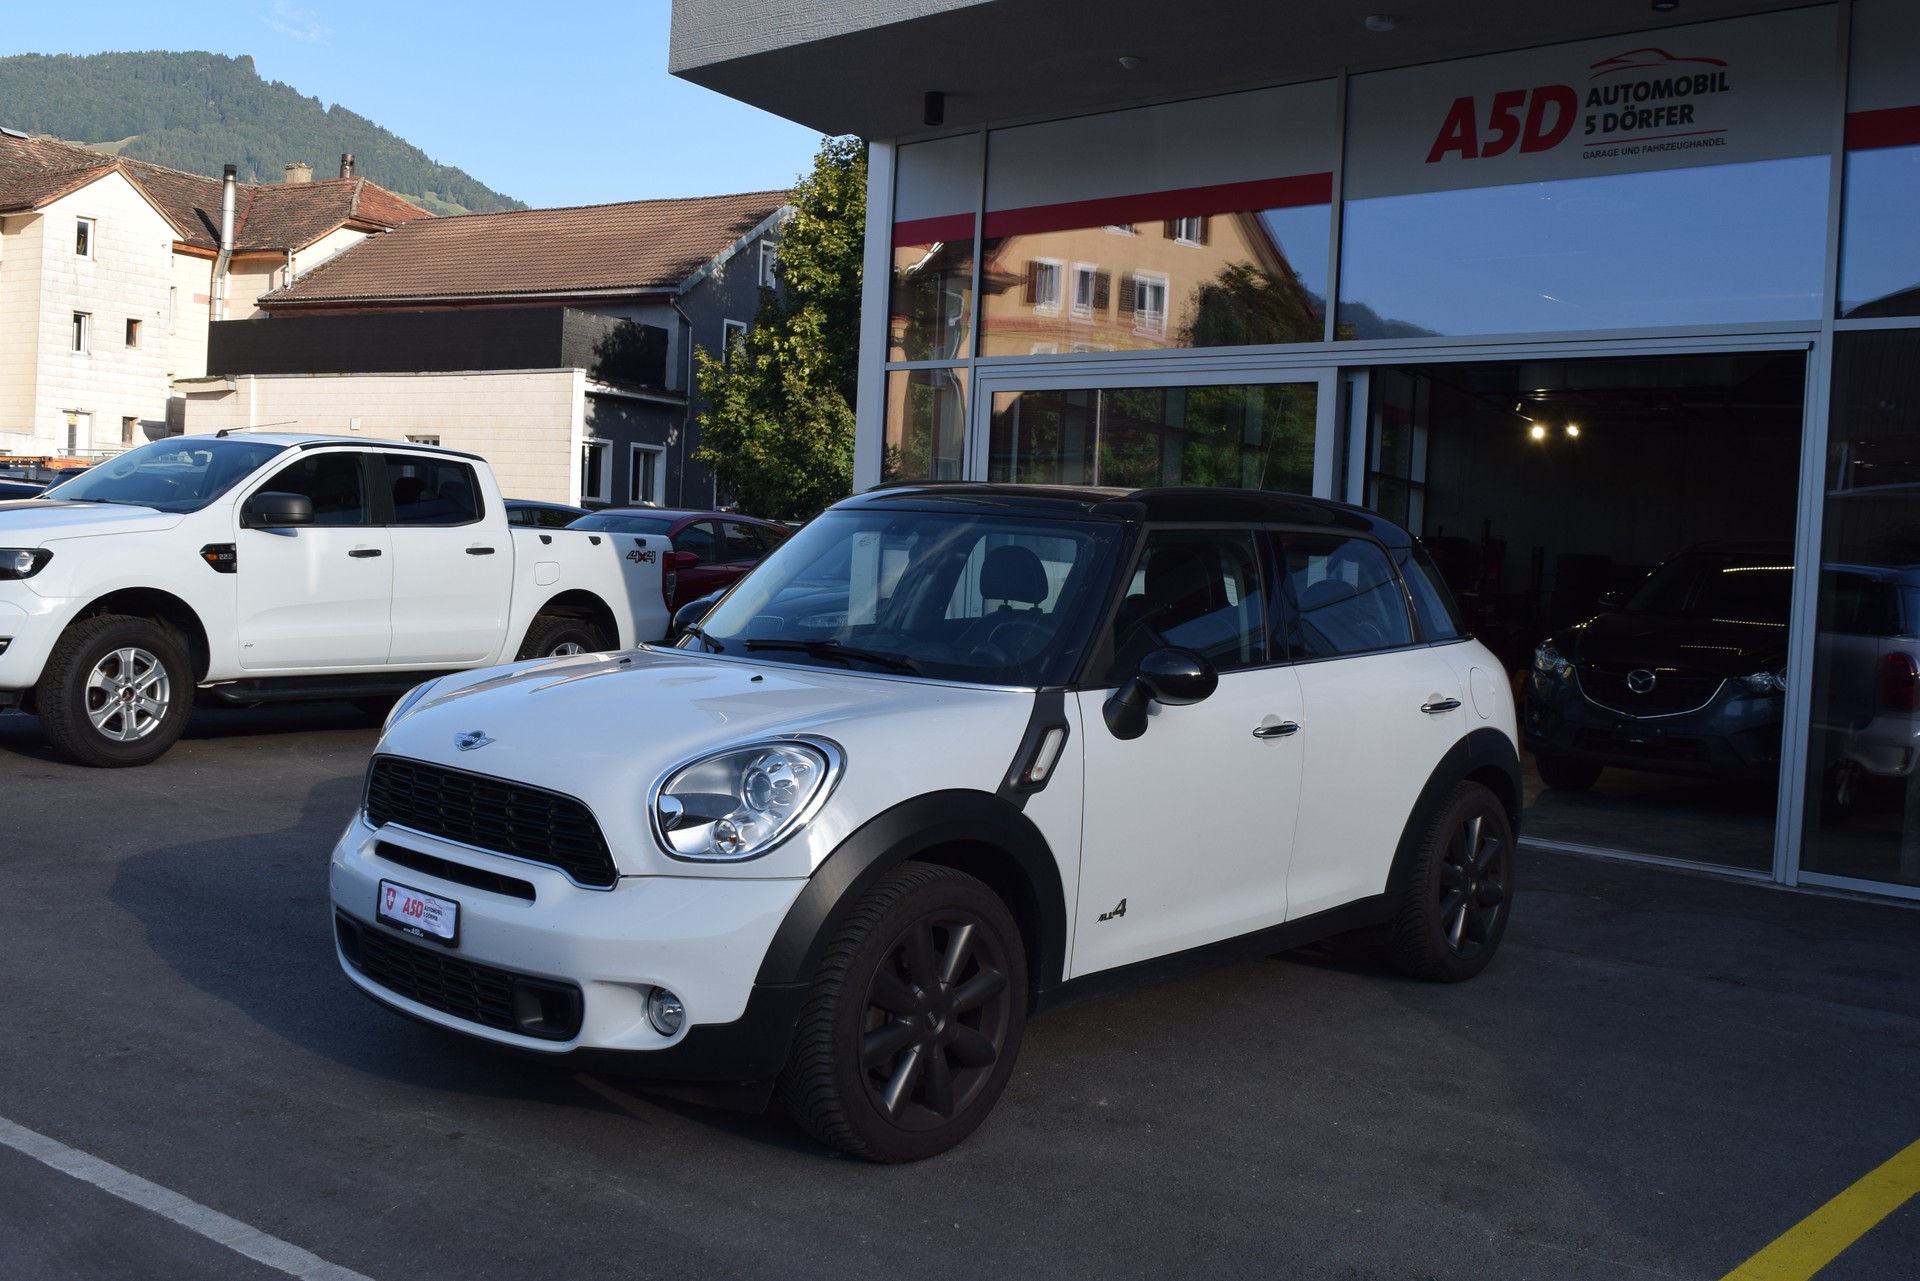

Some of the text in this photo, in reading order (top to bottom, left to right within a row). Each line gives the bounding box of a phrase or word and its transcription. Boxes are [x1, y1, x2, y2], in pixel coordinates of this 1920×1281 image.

[1585, 72, 1730, 108] AUTOMOBIL
[1425, 84, 1578, 163] A5D
[1584, 104, 1694, 135] 5 DÖRFER
[1583, 137, 1727, 160] GARAGE UND FAHRZEUGHANDEL
[402, 897, 424, 918] A5D
